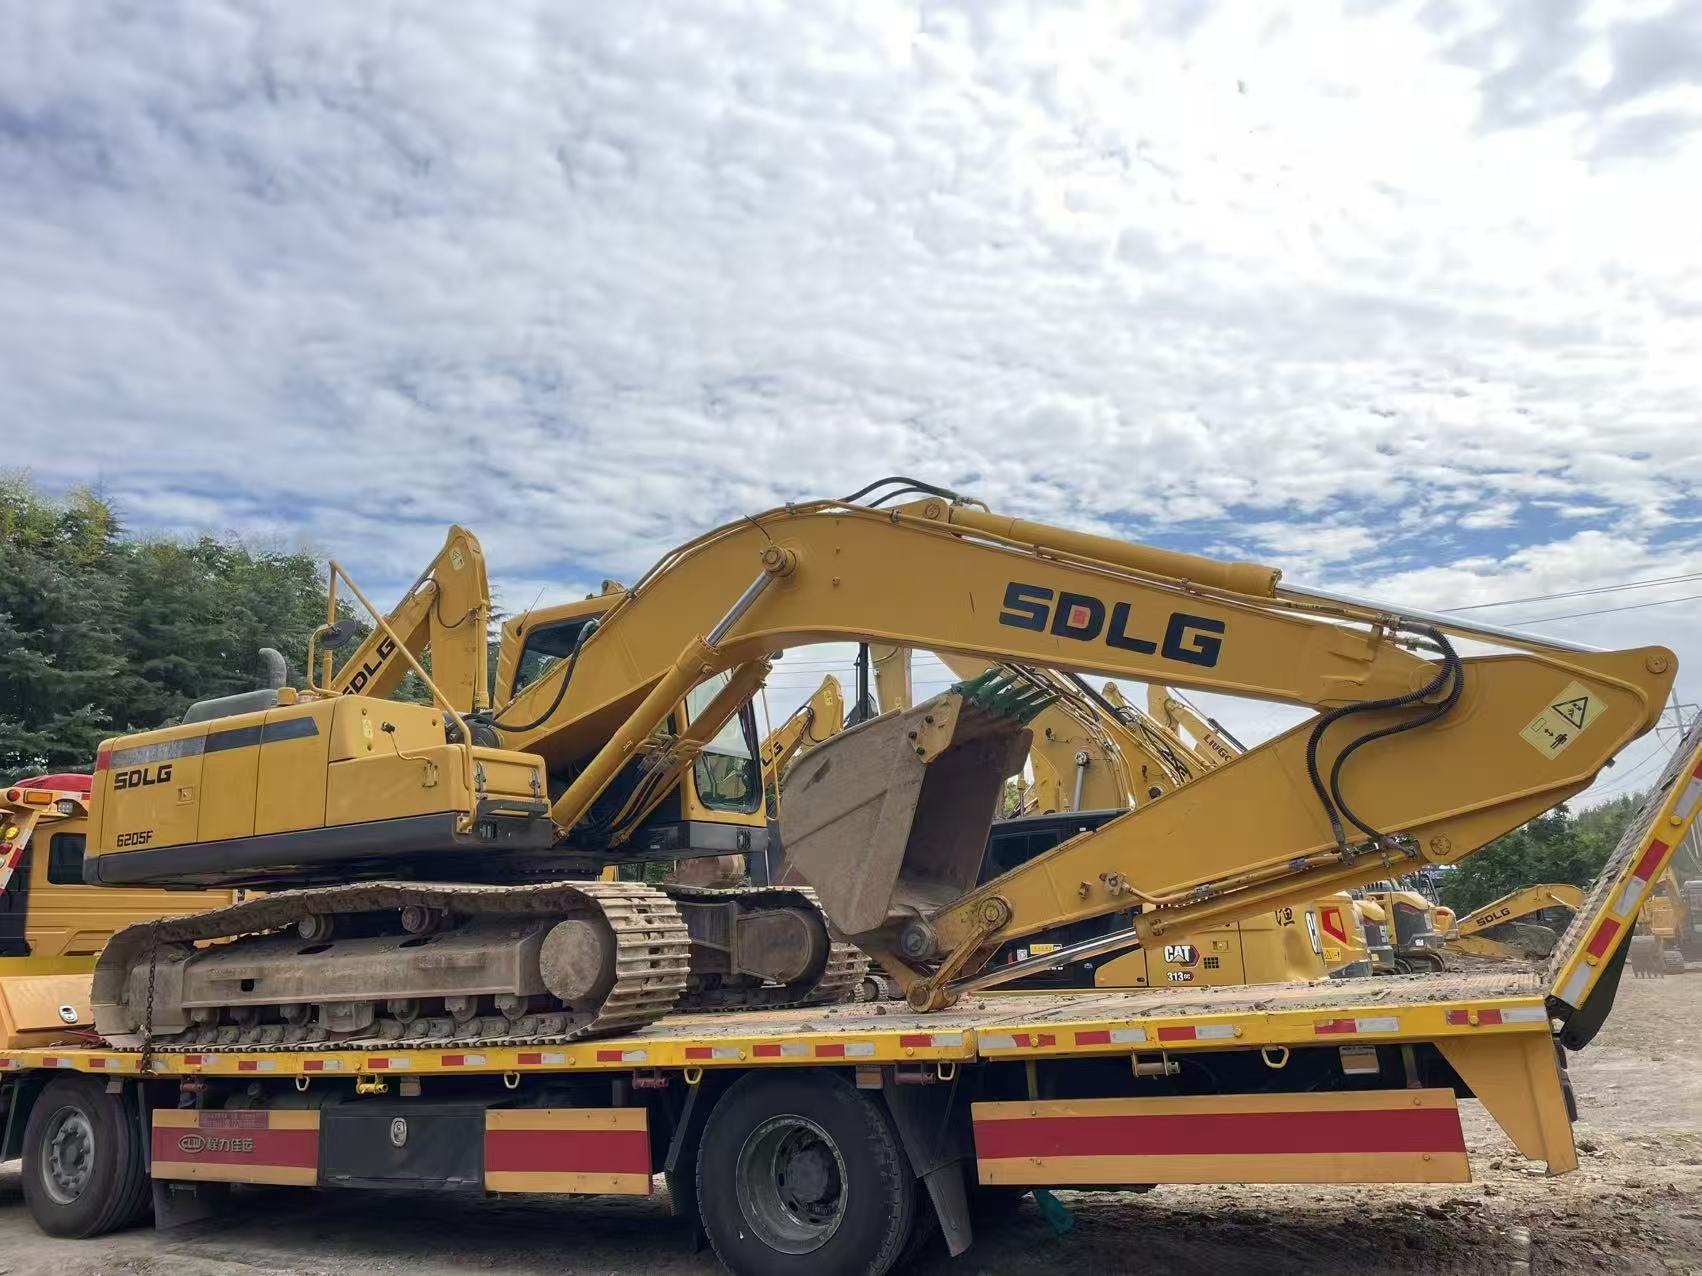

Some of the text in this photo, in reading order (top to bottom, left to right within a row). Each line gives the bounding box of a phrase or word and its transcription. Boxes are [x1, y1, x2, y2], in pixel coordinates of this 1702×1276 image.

[998, 581, 1226, 668] SDLG
[113, 763, 173, 791] SDLG
[116, 830, 154, 848] 6205F
[1475, 907, 1511, 927] SDLG
[1164, 945, 1191, 963] CAT
[1167, 971, 1184, 982] 313
